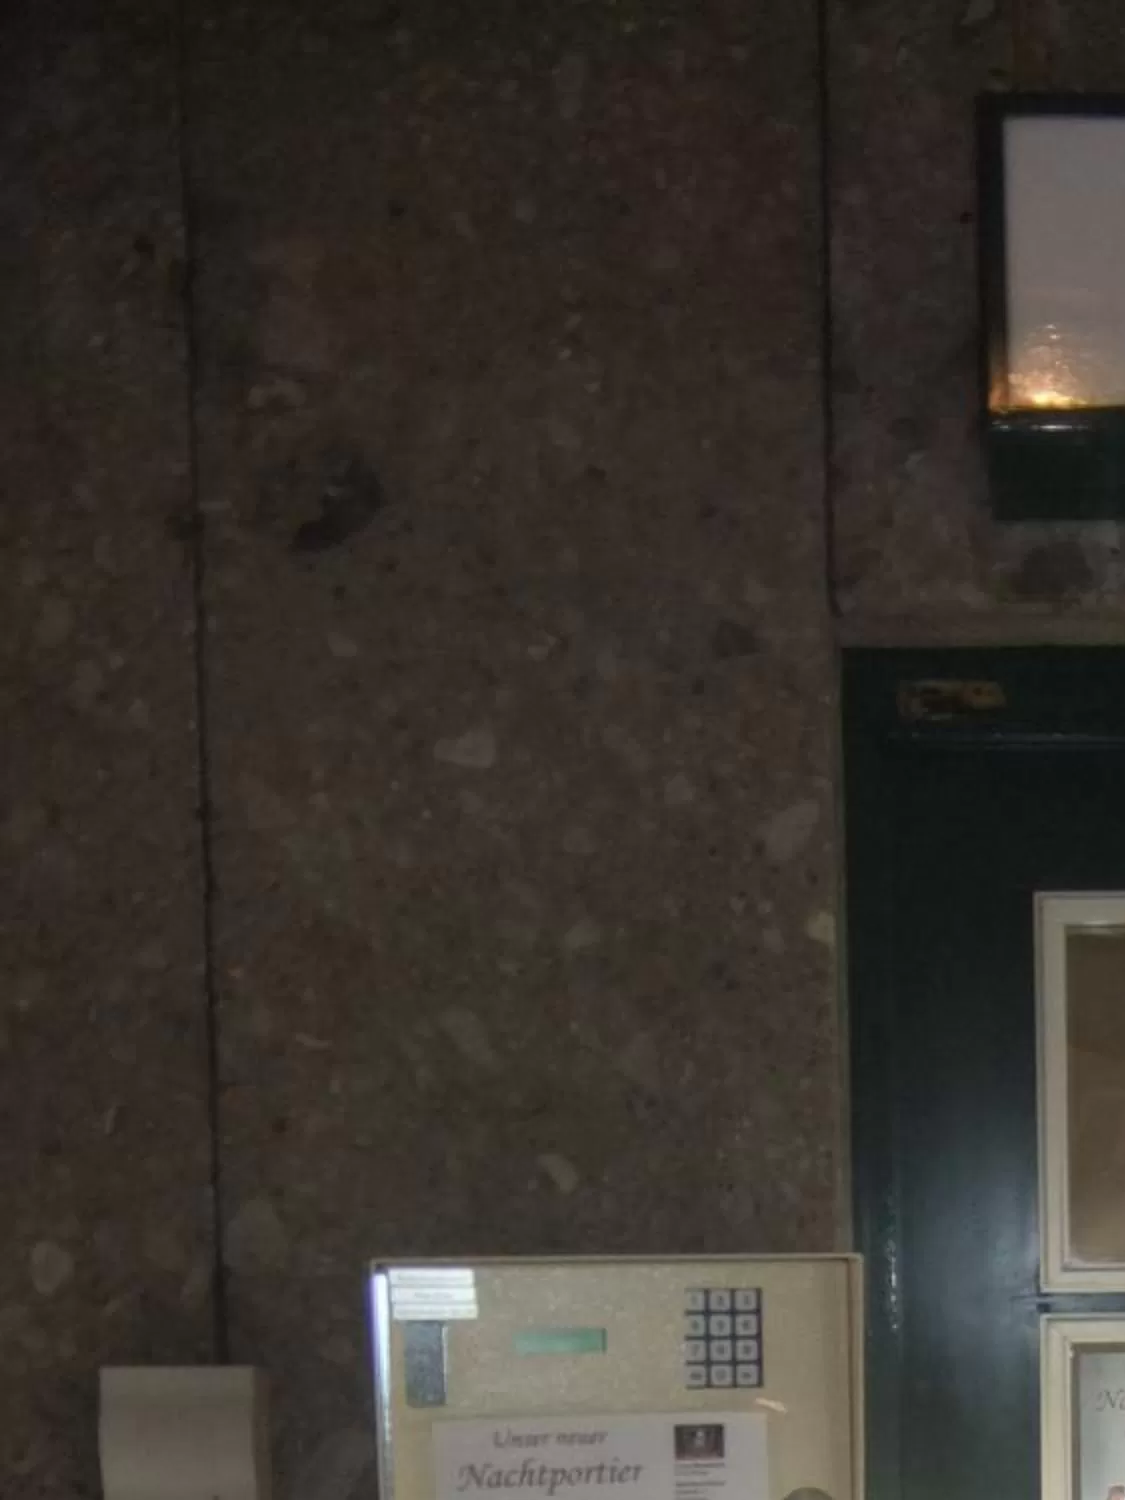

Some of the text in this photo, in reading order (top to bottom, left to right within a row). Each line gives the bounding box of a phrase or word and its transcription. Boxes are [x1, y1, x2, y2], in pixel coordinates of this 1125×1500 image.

[492, 1426, 609, 1448] Unser neuer
[456, 1456, 644, 1496] Nachtportier
